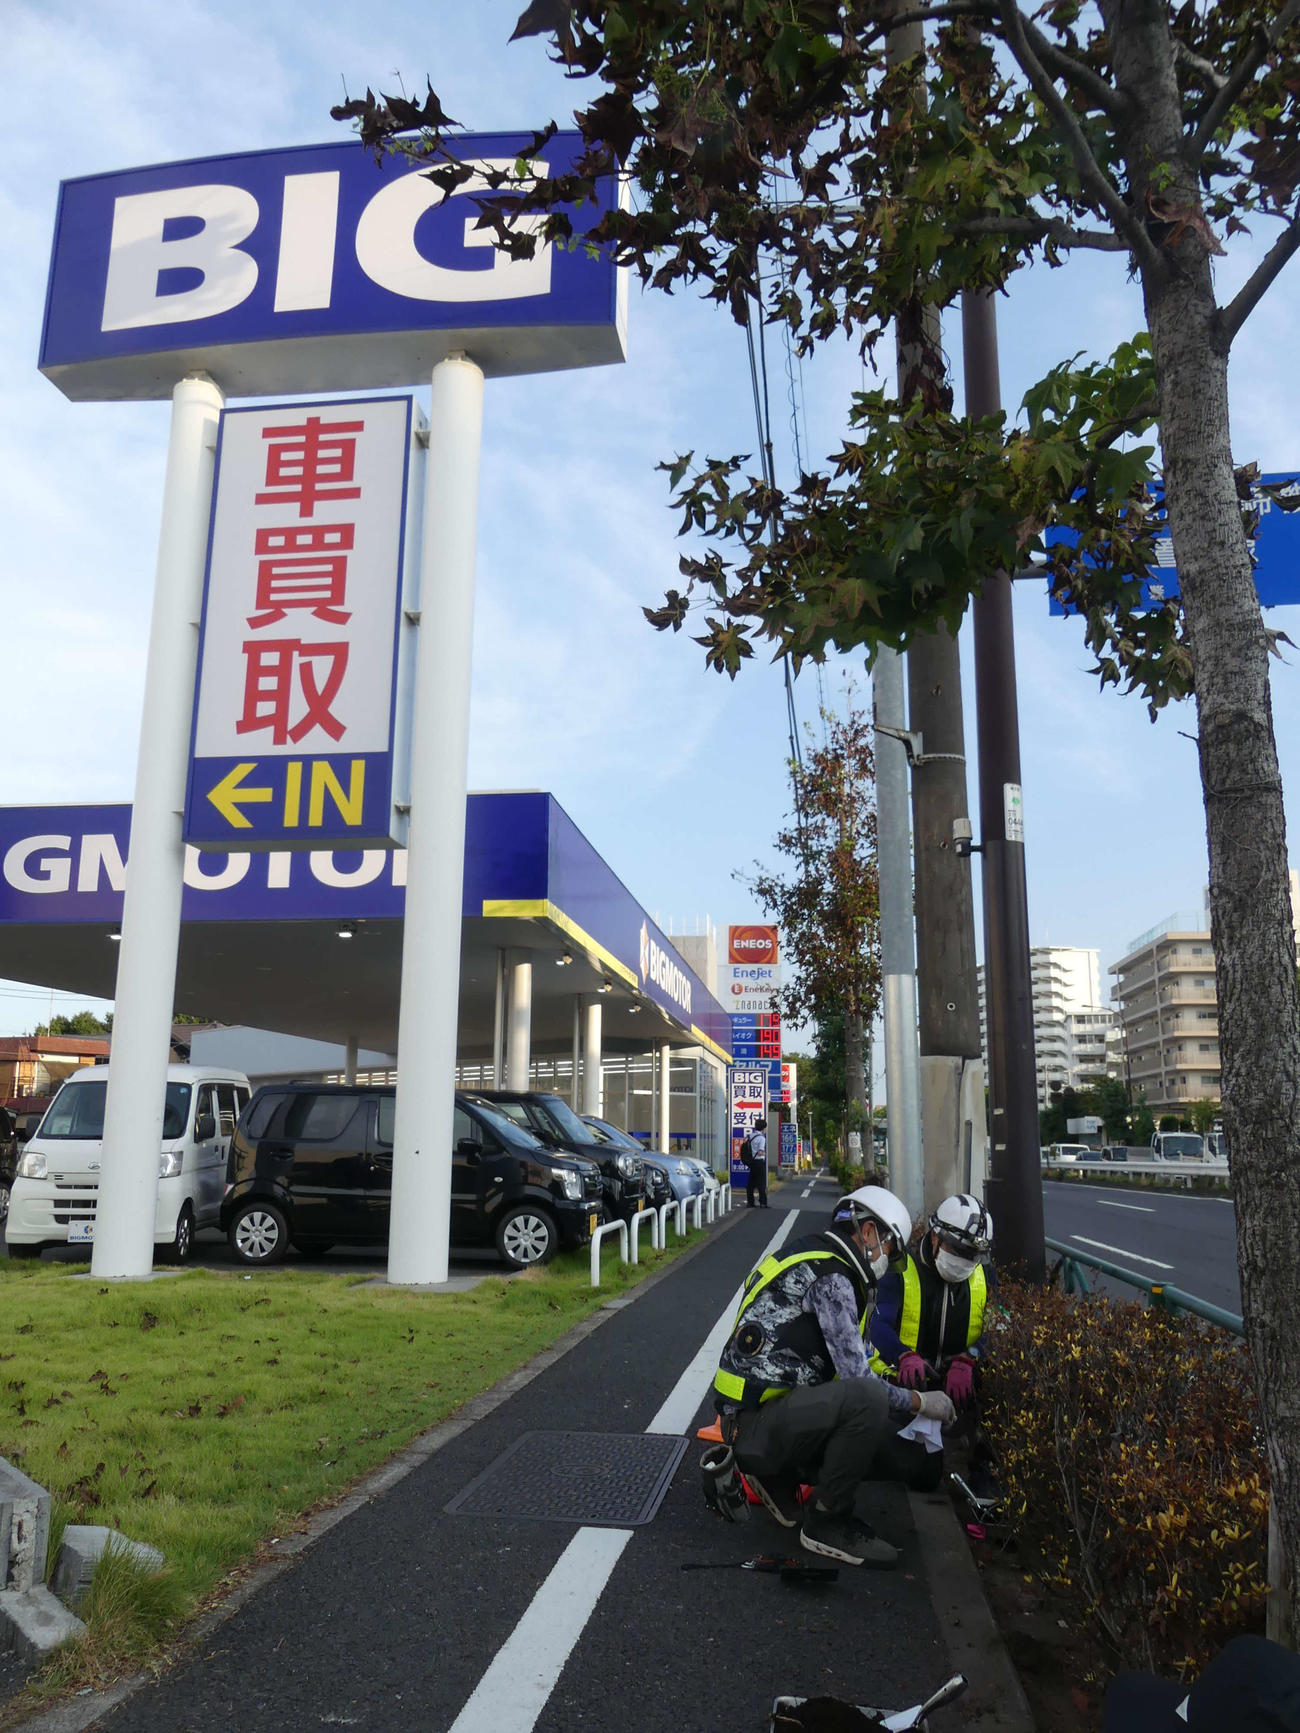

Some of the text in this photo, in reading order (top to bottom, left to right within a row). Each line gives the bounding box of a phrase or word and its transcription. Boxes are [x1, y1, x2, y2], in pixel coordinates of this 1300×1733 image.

[101, 156, 551, 333] BIG
[236, 416, 364, 746] 車買取
[283, 759, 365, 827] IN
[3, 834, 408, 893] GMOTO
[733, 939, 772, 949] ENEOS
[650, 939, 691, 1014] BIGMOTOR
[741, 1000, 770, 1010] nanac
[761, 1030, 780, 1043] 190
[761, 1045, 780, 1058] 149
[734, 1072, 763, 1083] BIG
[734, 1085, 762, 1098] 買取
